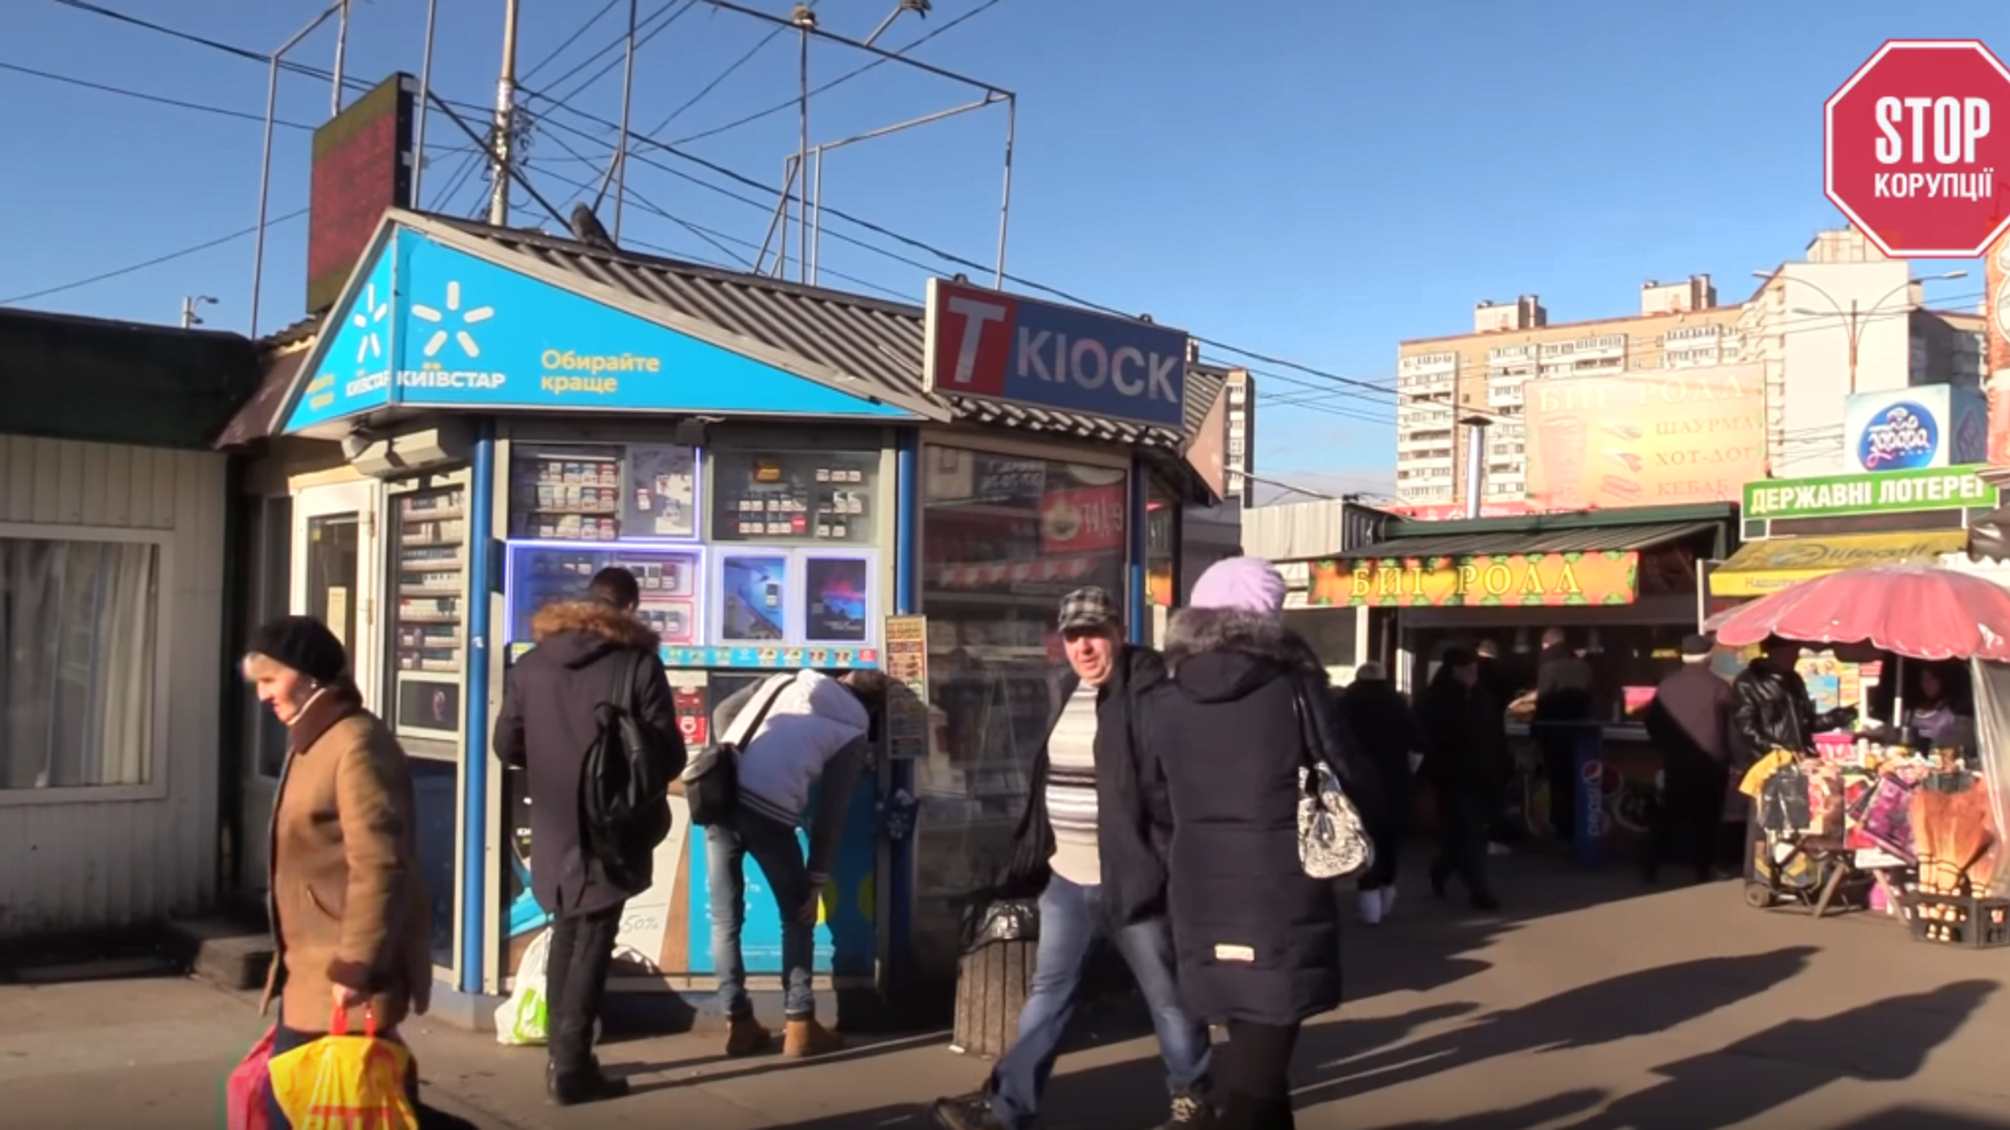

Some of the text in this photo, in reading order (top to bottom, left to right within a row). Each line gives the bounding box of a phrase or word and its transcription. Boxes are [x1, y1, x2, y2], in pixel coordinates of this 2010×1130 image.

[541, 349, 660, 375] Обирайте
[541, 375, 618, 395] краще
[1636, 373, 1747, 406] РОЛЛ
[1655, 416, 1755, 436] ШАУРМА
[1655, 446, 1756, 467] ХОТ-ДОГ
[1656, 478, 1729, 496] КЕБАБ
[1751, 482, 1872, 514] ДЕРЖАВНІ
[1351, 563, 1583, 597] БИГ РОЛЛ
